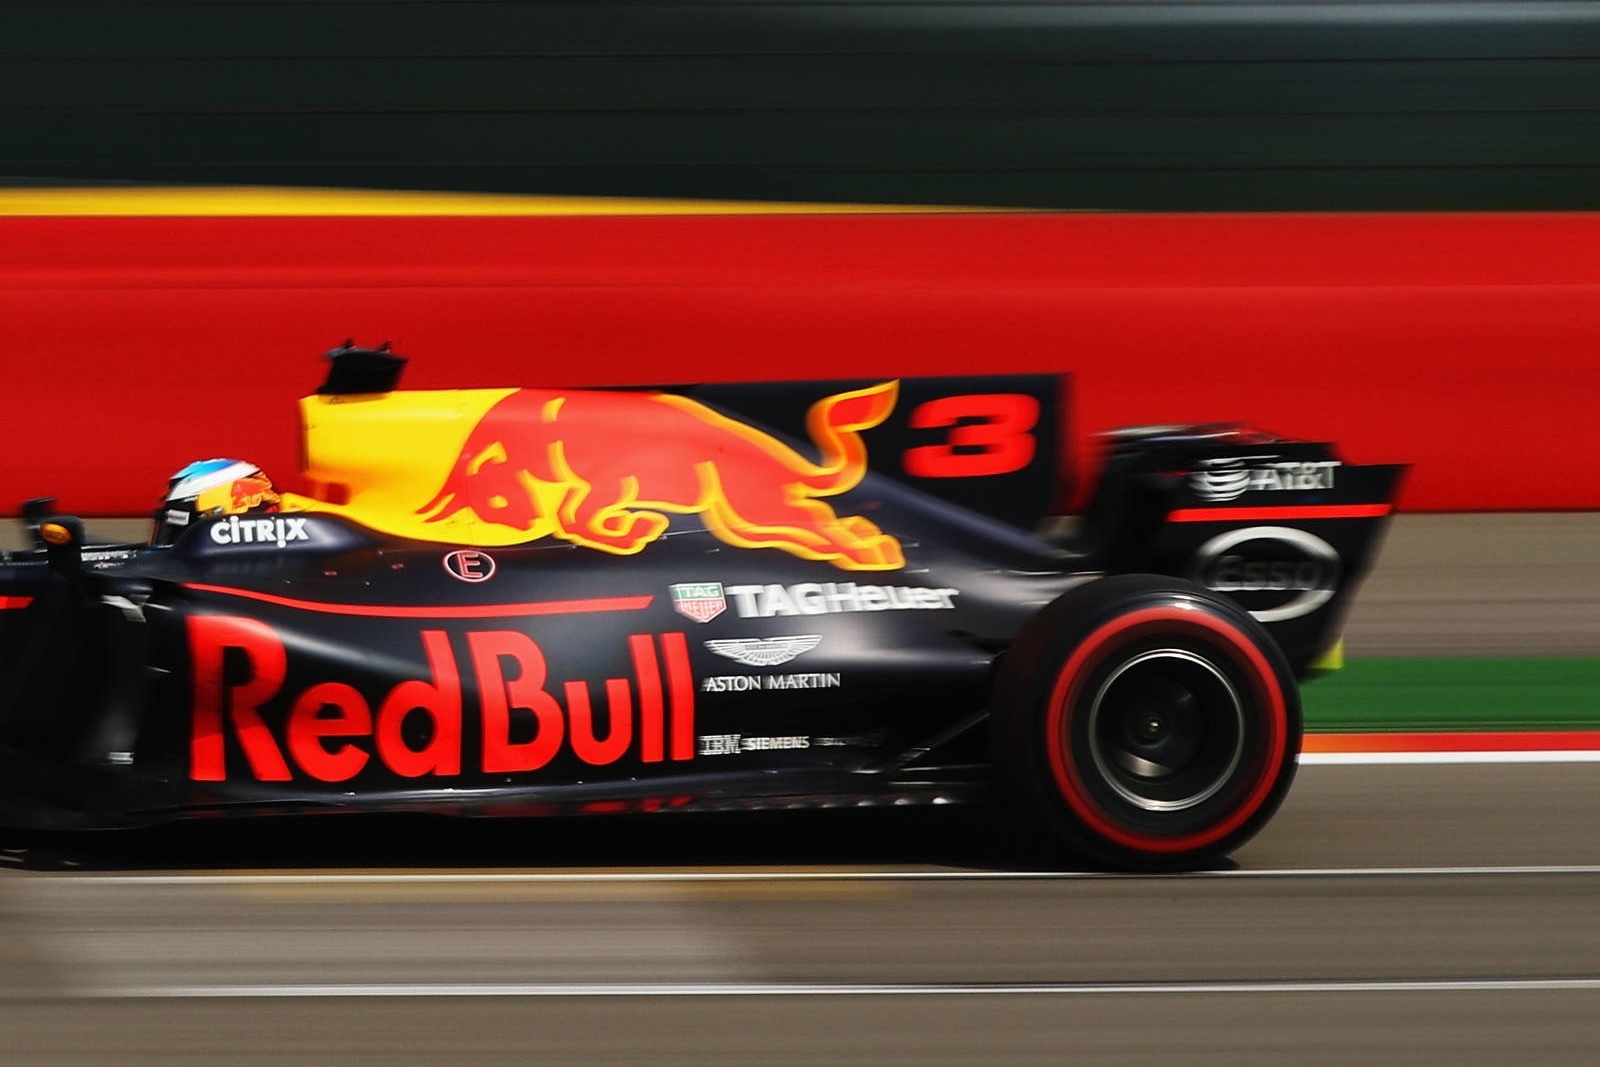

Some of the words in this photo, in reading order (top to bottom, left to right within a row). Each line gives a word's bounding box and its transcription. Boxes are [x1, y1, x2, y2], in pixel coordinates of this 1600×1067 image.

[903, 393, 1040, 478] 3
[1247, 461, 1342, 491] AT&T
[457, 551, 484, 578] E
[679, 585, 720, 598] TAG
[702, 675, 762, 692] ASTON
[764, 673, 841, 690] MARTIN
[699, 734, 742, 755] IBM
[743, 736, 810, 750] SIEMENS
